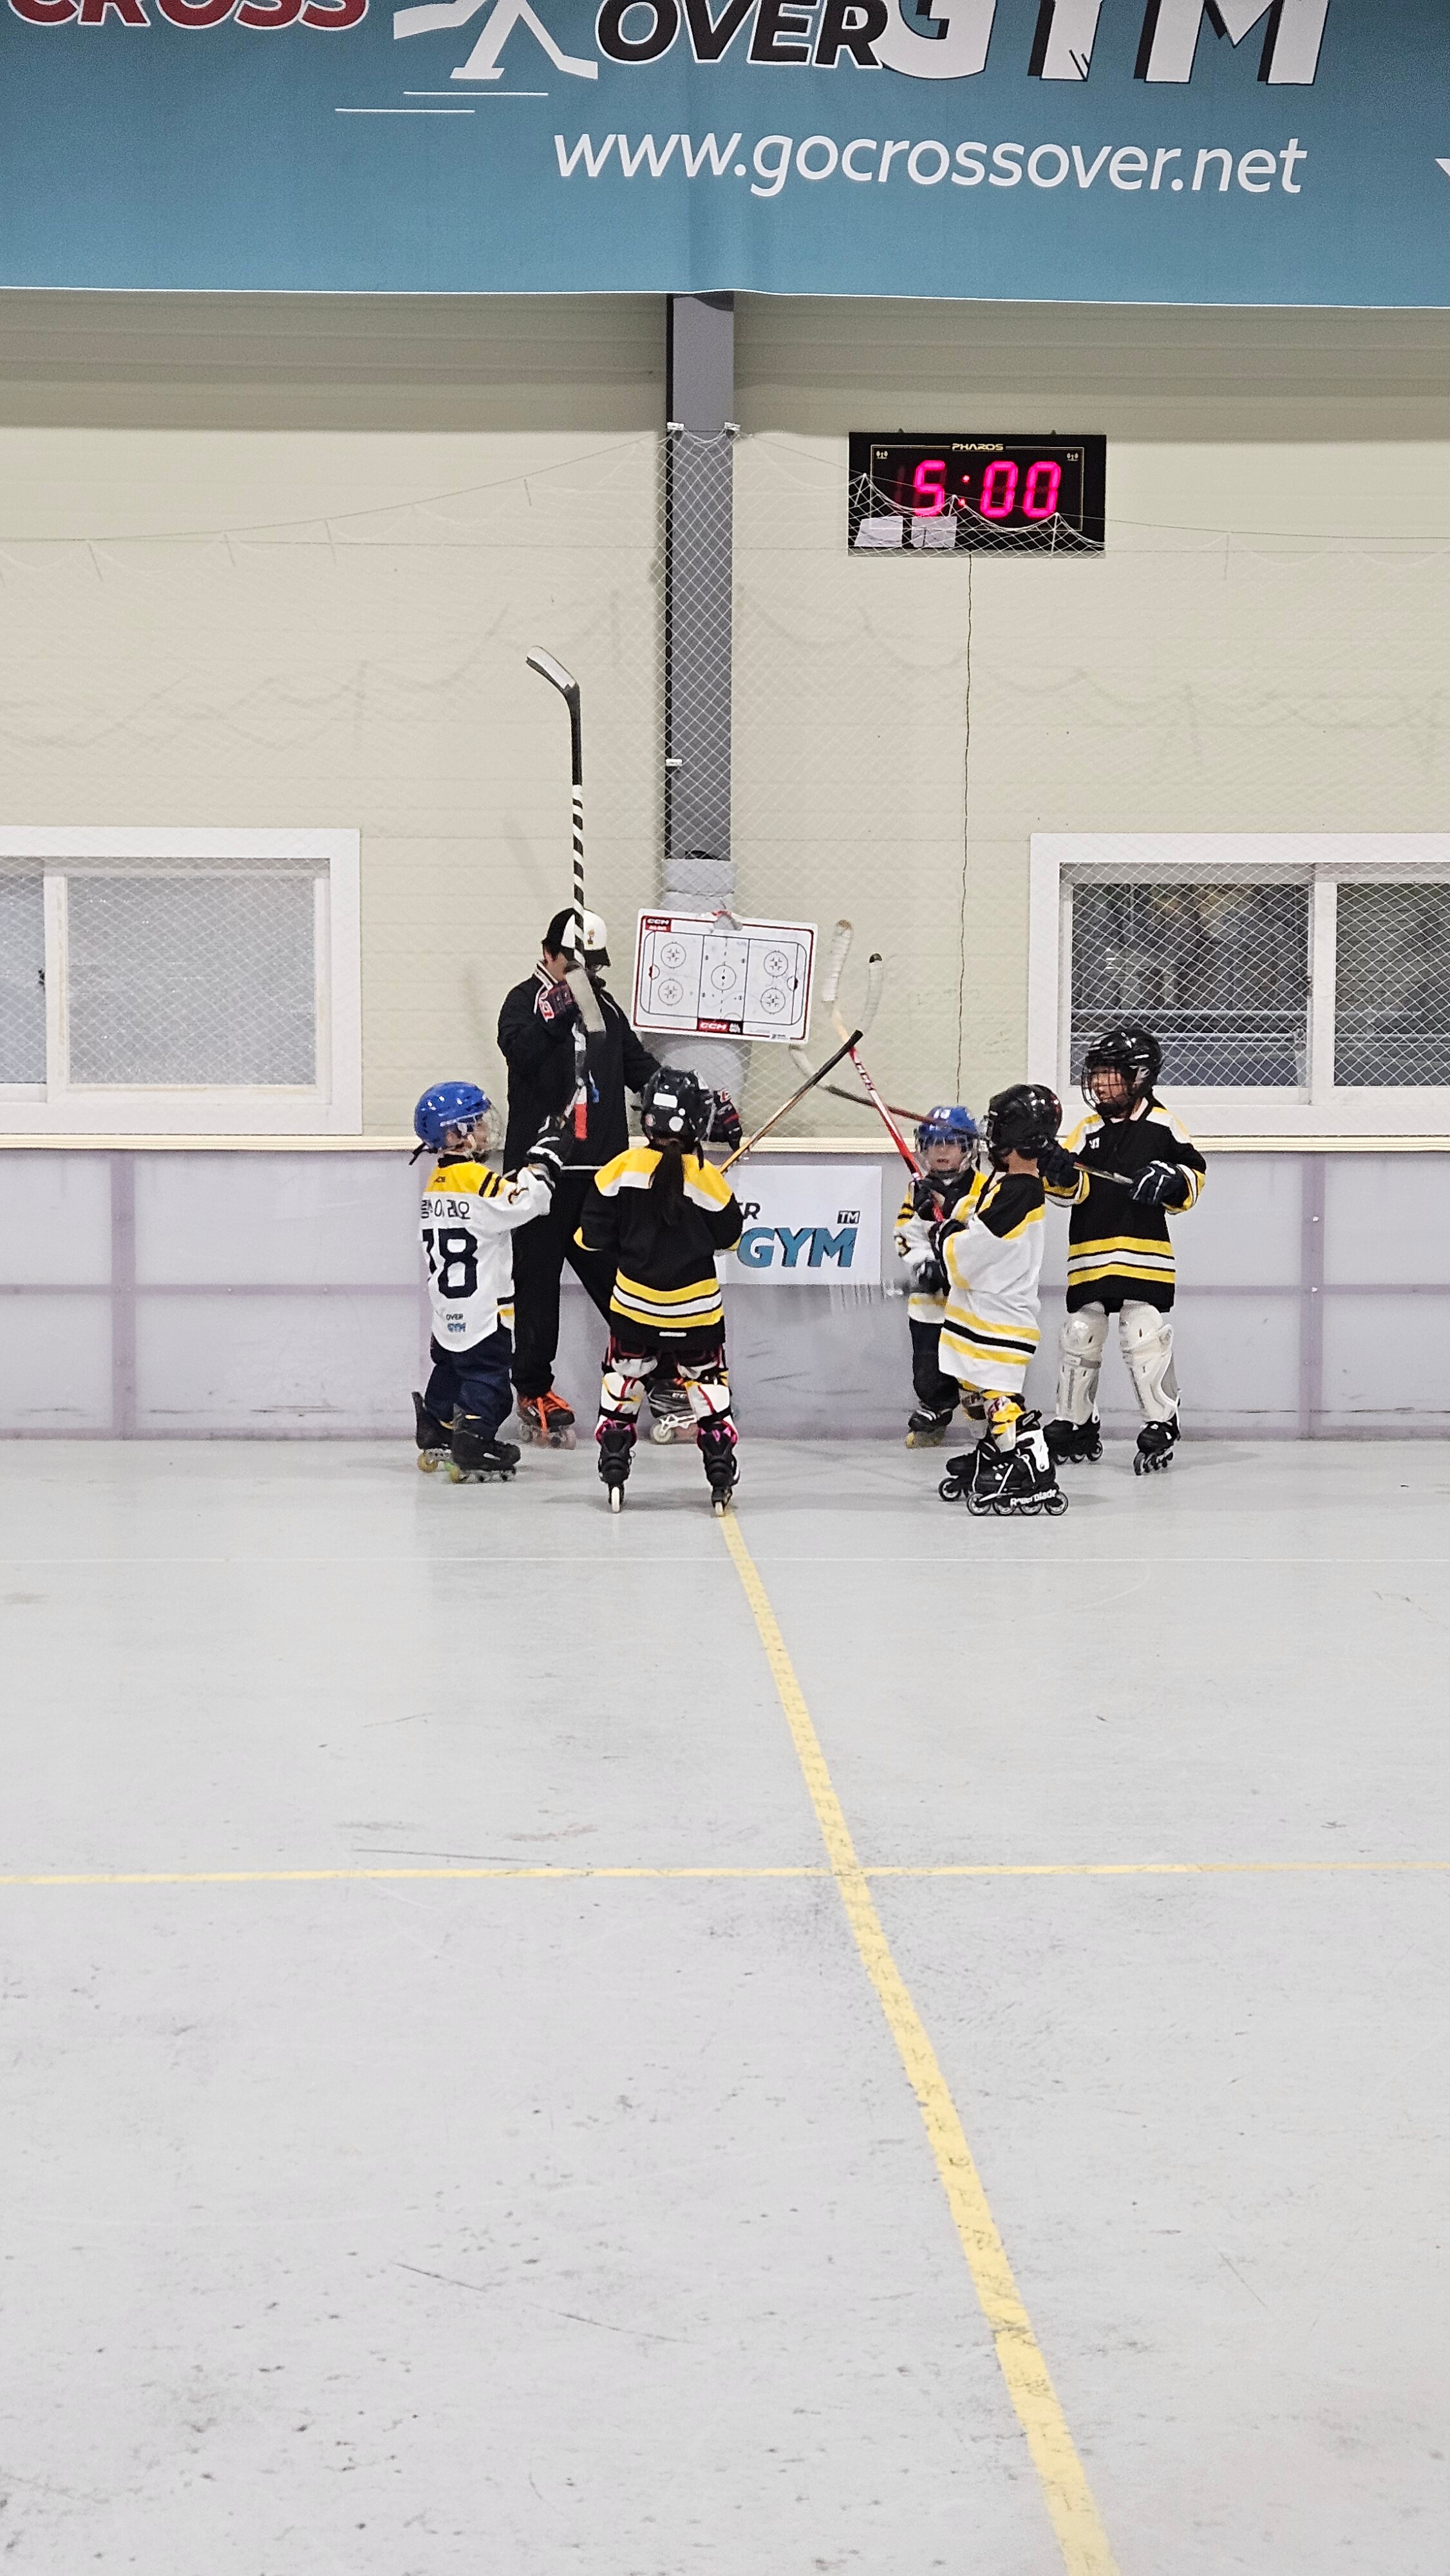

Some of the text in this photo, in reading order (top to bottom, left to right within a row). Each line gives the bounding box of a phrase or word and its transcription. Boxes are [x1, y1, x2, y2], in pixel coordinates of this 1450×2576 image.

[595, 0, 888, 68] OVER
[555, 133, 1307, 196] www.gocrossover.net
[914, 460, 1061, 517] 5:00
[700, 1021, 728, 1030] CCM
[838, 1211, 860, 1224] TM
[737, 1227, 858, 1267] GYM
